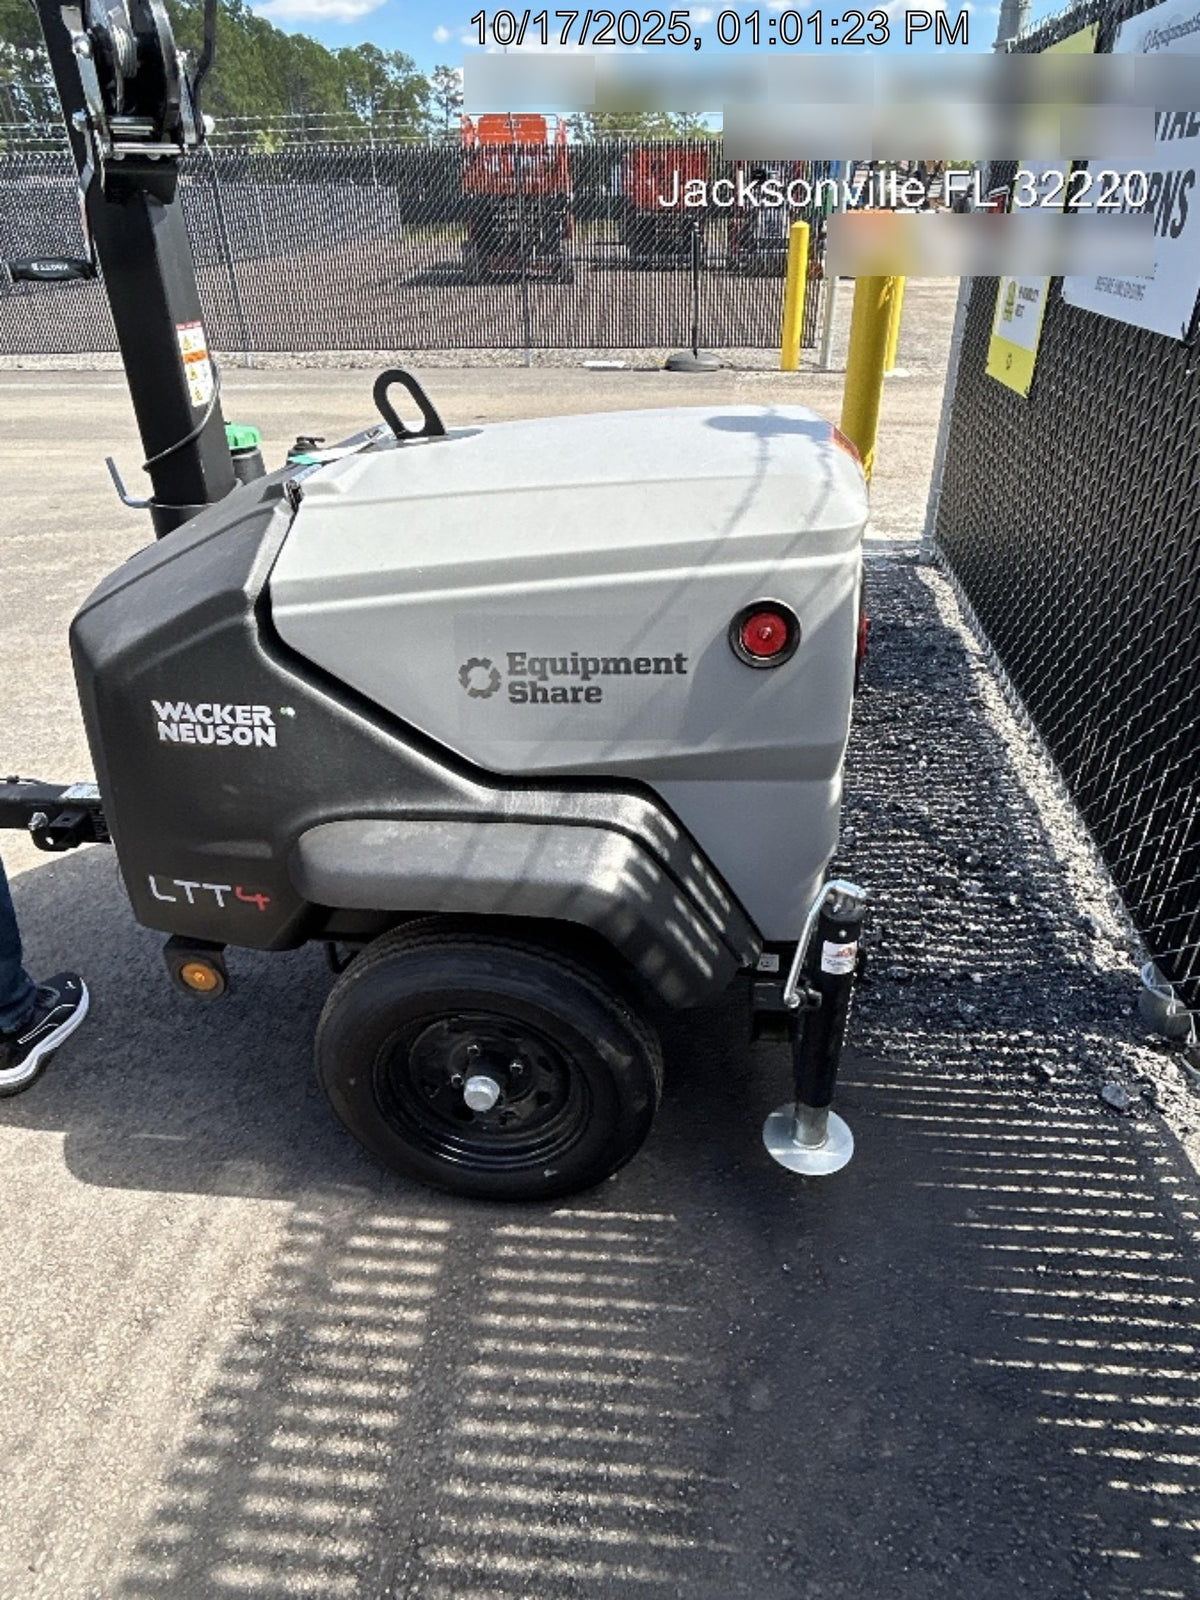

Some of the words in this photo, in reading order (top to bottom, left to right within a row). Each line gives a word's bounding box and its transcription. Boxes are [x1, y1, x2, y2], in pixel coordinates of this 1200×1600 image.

[506, 652, 688, 681] Equipment
[508, 681, 602, 704] Share
[151, 700, 276, 726] WACKER
[157, 721, 277, 747] NEUSON
[149, 875, 271, 911] LTT4
